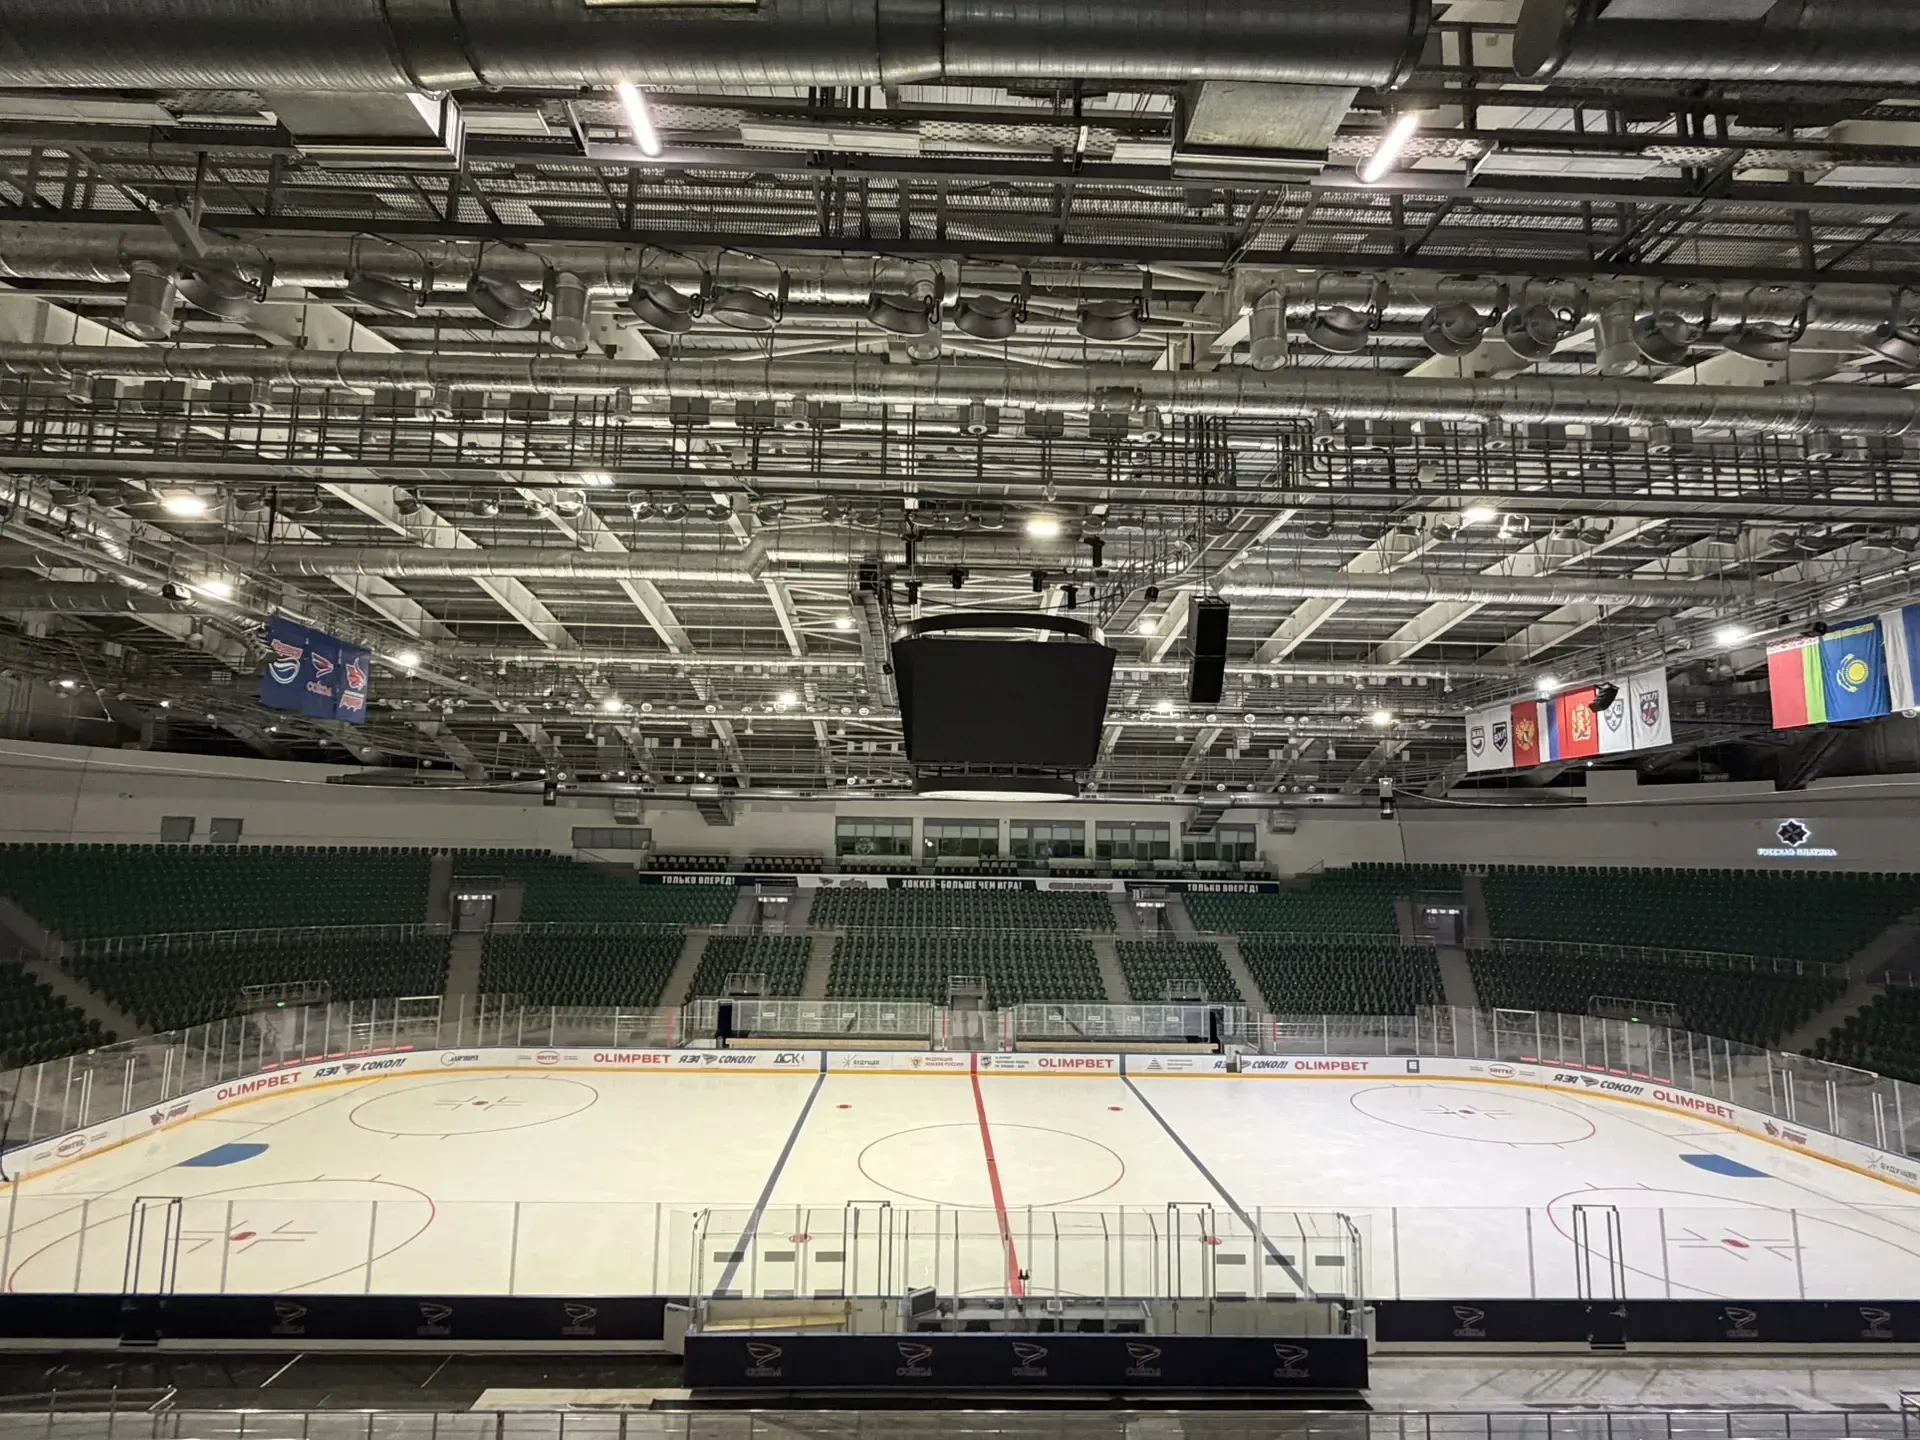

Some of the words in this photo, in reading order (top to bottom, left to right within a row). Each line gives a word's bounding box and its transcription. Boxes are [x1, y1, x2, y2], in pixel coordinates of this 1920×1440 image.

[662, 876, 697, 884] ТОЛЬКО
[978, 881, 996, 890] ЧЕМ
[997, 881, 1022, 890] ИГРА!
[1187, 884, 1221, 892] ТОЛЬКО
[593, 1053, 671, 1064] OLIMPBET
[718, 1055, 756, 1064] СОКОЛ!
[1038, 1058, 1114, 1068] OLIMPBET
[361, 1058, 407, 1072] СОКОЛ!
[1252, 1060, 1289, 1069] СОКОЛ!
[1294, 1061, 1368, 1071] OLIMPBET
[216, 1071, 301, 1101] OLIMPBET
[1599, 1080, 1644, 1096] СОКОЛ!
[1653, 1090, 1735, 1119] OLIMPBET
